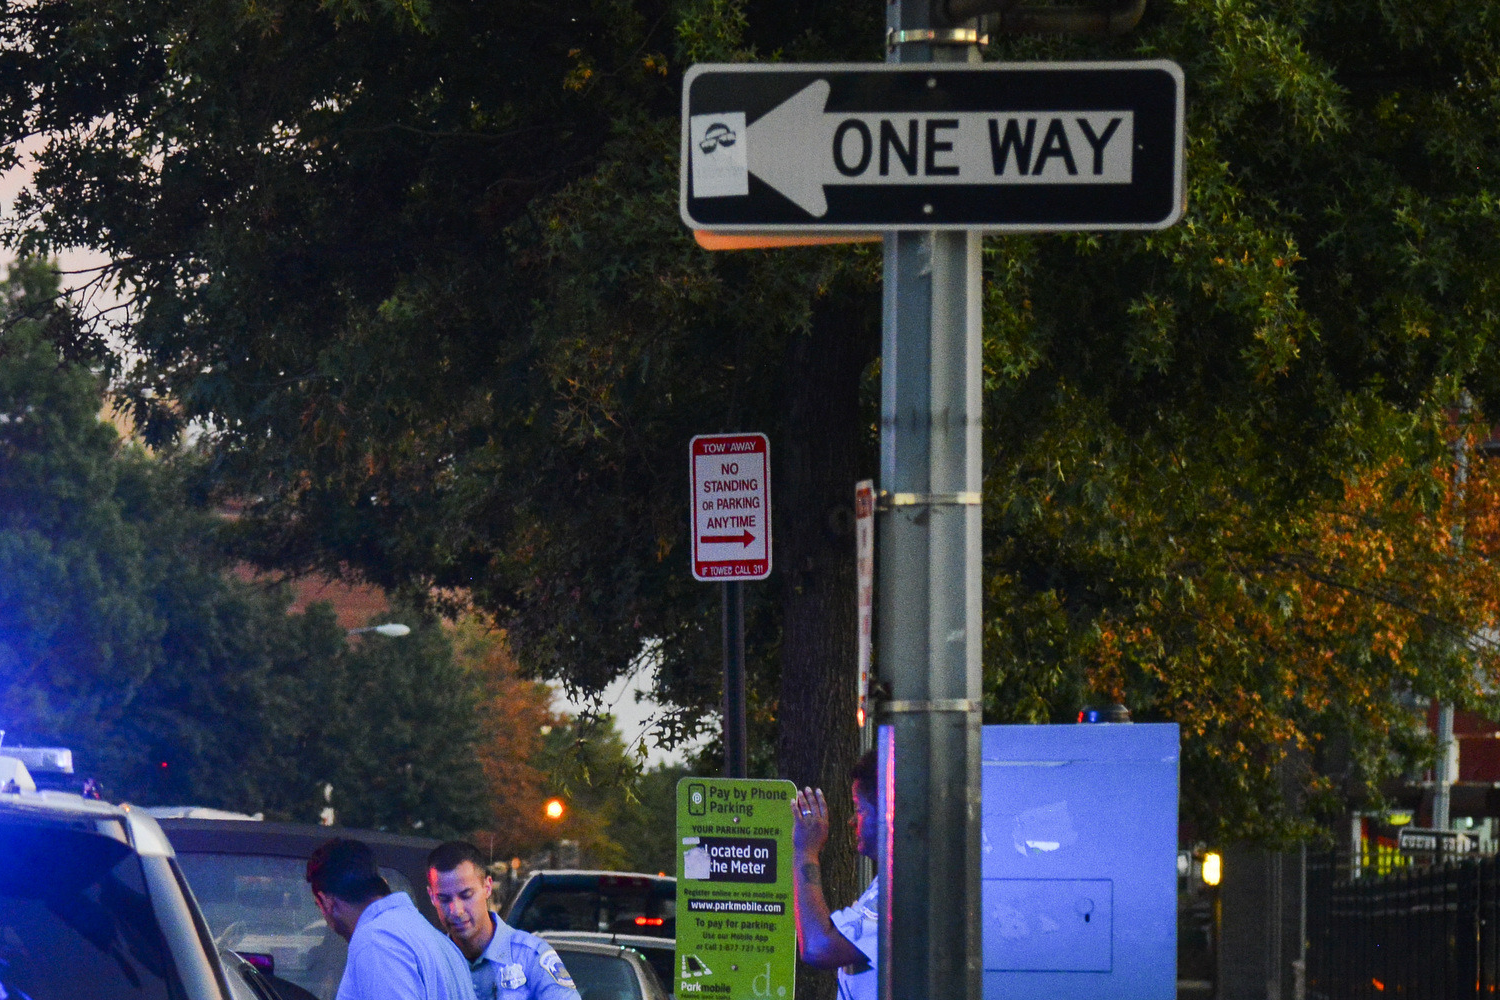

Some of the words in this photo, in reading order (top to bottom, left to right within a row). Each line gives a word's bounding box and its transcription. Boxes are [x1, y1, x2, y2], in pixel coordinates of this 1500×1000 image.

[832, 118, 960, 177] ONE
[987, 118, 1122, 176] WAY
[703, 443, 726, 453] TOW
[730, 441, 756, 451] AWAY
[721, 463, 739, 475] NO
[704, 479, 758, 493] STANDING
[702, 501, 714, 511] OR
[716, 497, 760, 510] PARKING
[707, 515, 756, 529] ANYTIME
[710, 566, 733, 576] TOWED
[735, 565, 751, 575] CALL
[753, 564, 764, 574] 311
[709, 786, 730, 801] Pay
[734, 787, 747, 802] by
[751, 787, 787, 801] Phone
[710, 801, 753, 817] Parking
[692, 825, 714, 834] YOUR
[716, 826, 751, 835] PARKING
[754, 848, 769, 859] on
[731, 860, 766, 874] Meter
[691, 901, 781, 913] www.parkmobile.com
[696, 918, 705, 927] To
[708, 920, 723, 930] pay
[726, 919, 739, 928] for
[681, 981, 731, 993] Parkmobile
